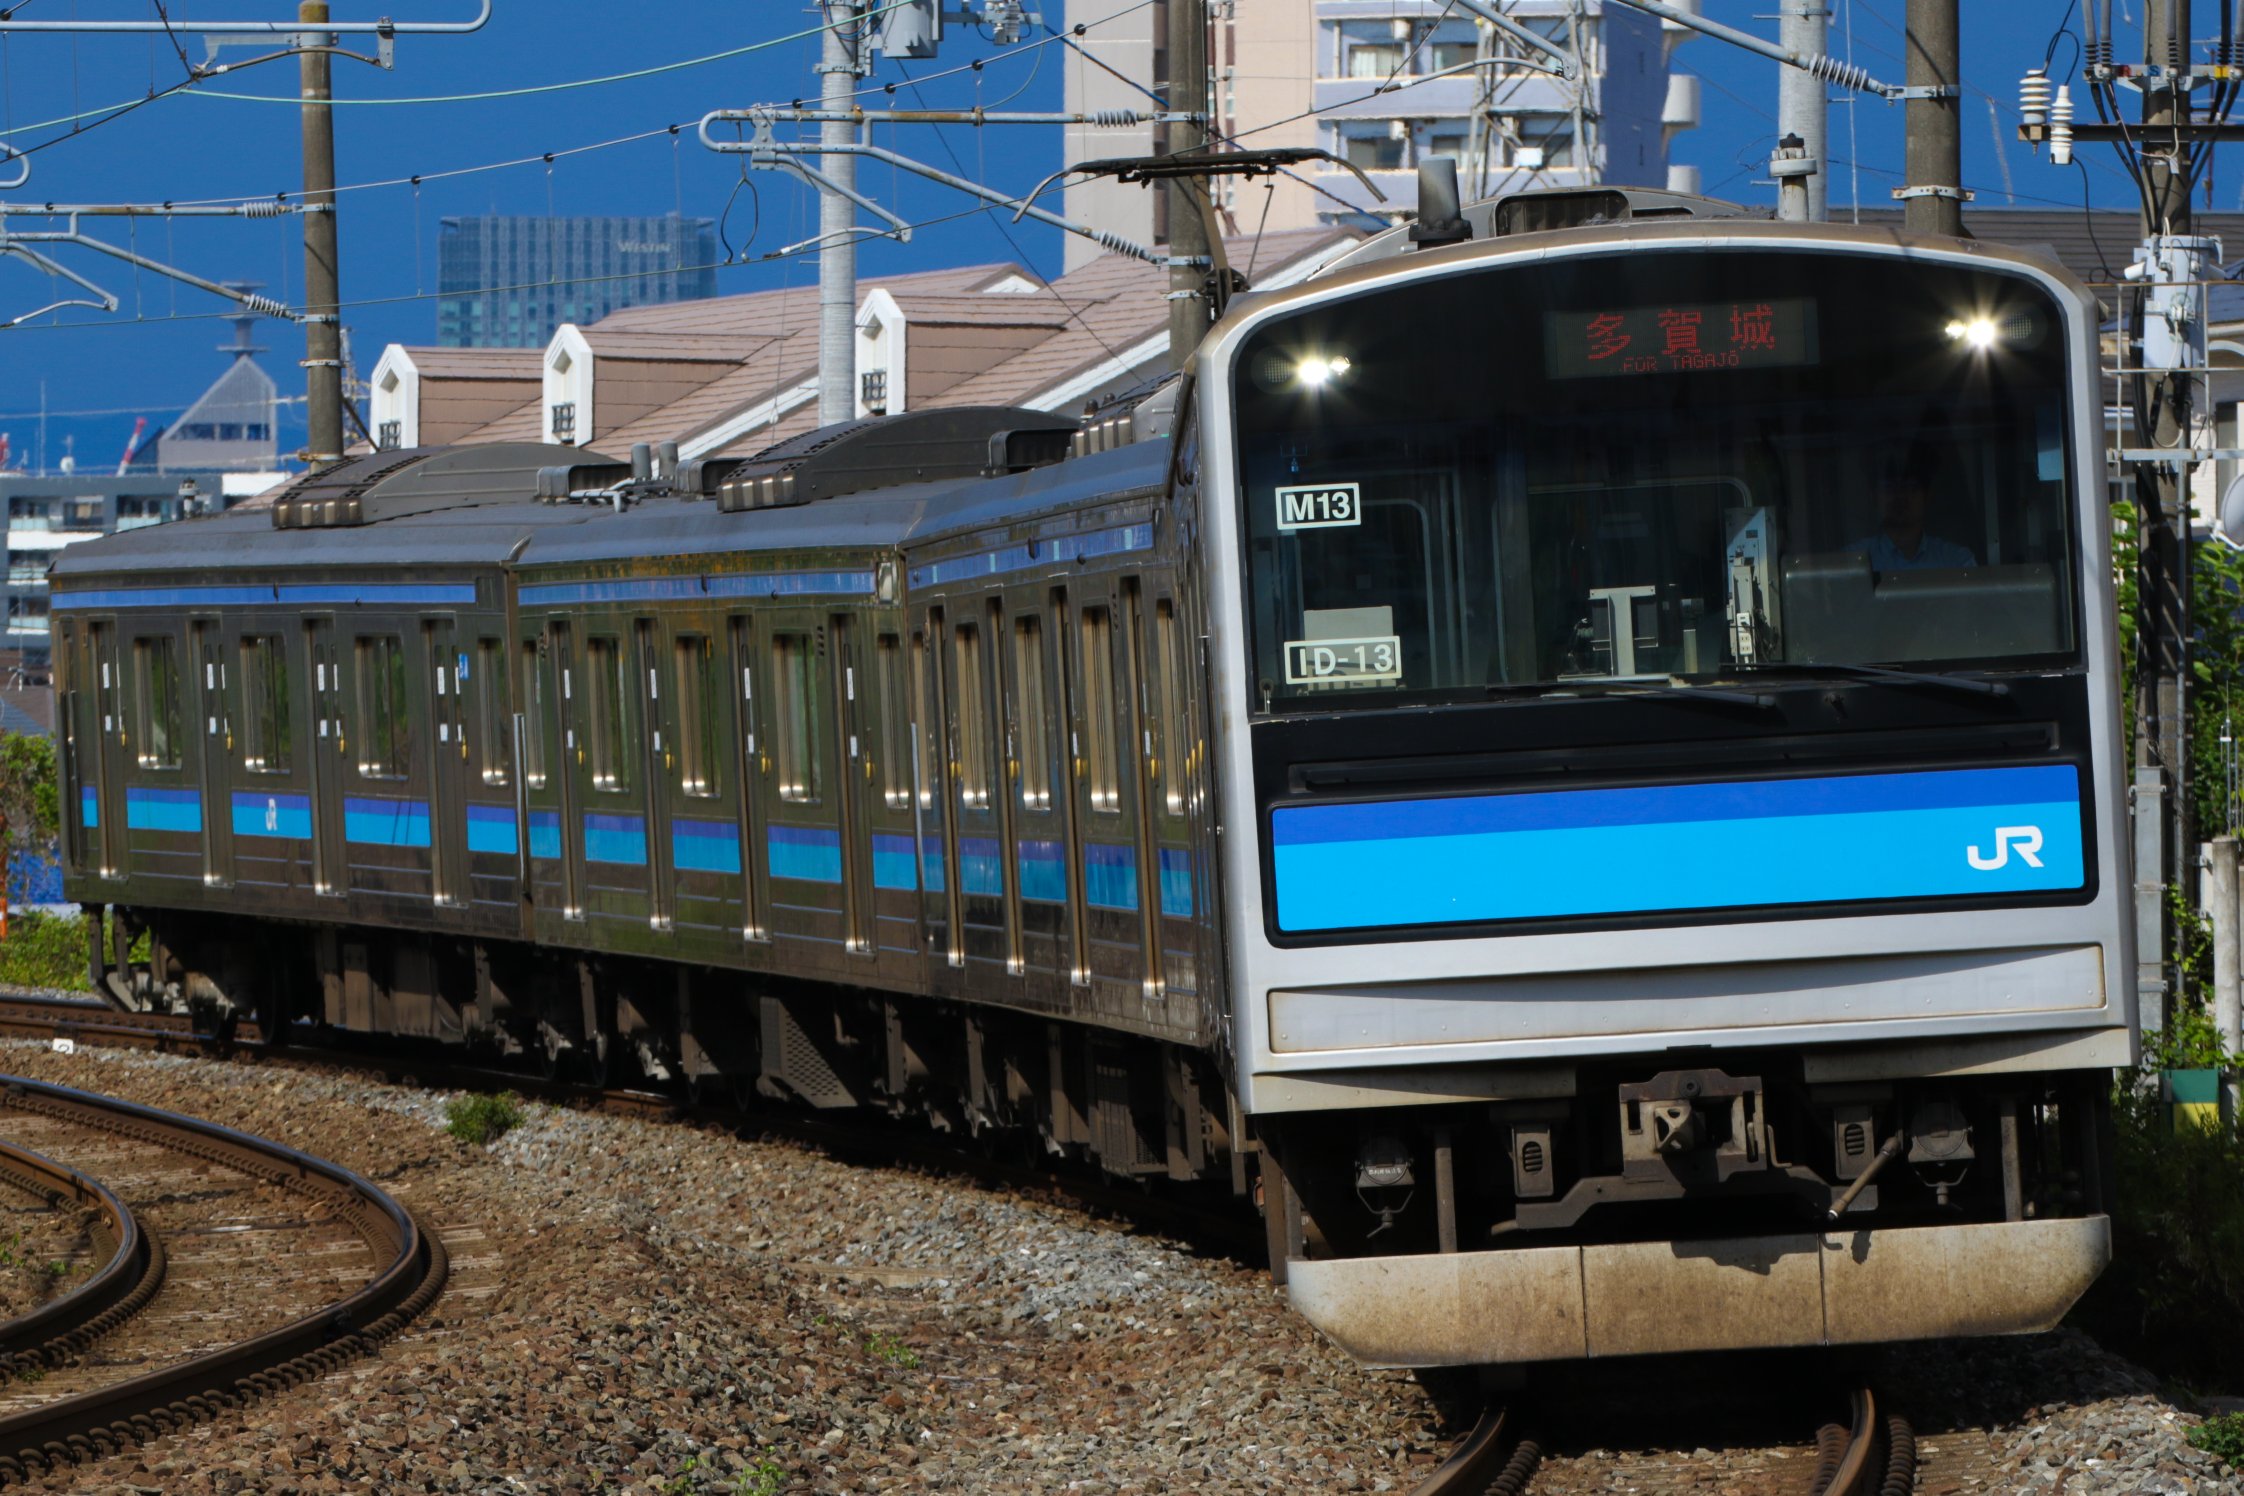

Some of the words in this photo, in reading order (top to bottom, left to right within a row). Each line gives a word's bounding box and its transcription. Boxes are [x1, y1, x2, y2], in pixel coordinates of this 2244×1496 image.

[2149, 65, 2160, 76] S
[1586, 304, 1775, 360] 多賀城
[1623, 356, 1657, 372] FOR
[1285, 491, 1351, 521] M13
[1299, 644, 1394, 676] ID-13
[265, 798, 278, 832] JR
[1967, 825, 2045, 870] JR
